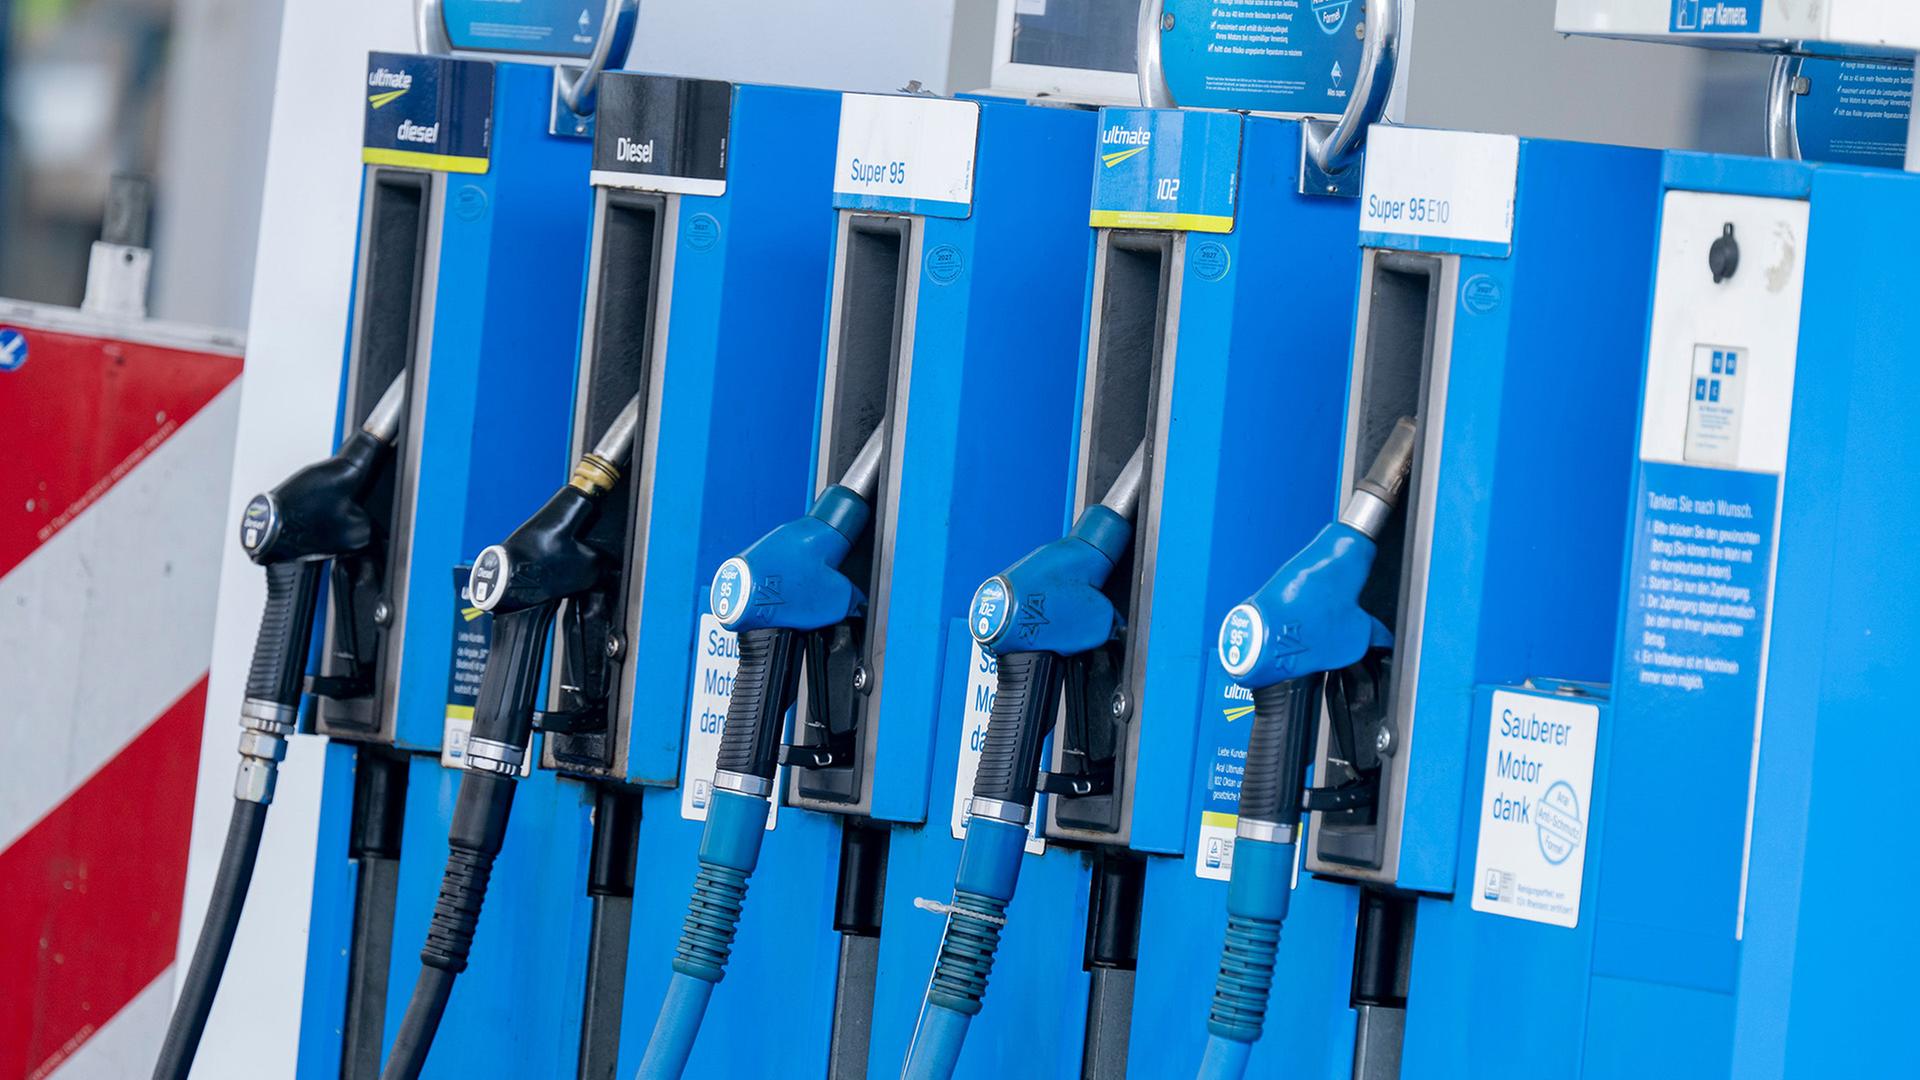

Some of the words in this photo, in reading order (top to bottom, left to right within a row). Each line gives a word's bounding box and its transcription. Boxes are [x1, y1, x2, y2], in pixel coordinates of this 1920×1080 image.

[369, 68, 412, 89] ultimate
[397, 119, 439, 143] diesel
[1102, 126, 1151, 145] ultimate
[616, 138, 654, 163] Diesel
[851, 158, 886, 187] Super
[890, 162, 905, 184] 95
[1156, 178, 1180, 200] 102
[1368, 194, 1405, 224] Super
[1409, 198, 1426, 221] 95
[1427, 199, 1450, 224] E10
[1648, 492, 1678, 510] Tanken
[1679, 495, 1693, 512] Sie
[1695, 498, 1715, 515] nach
[1717, 499, 1753, 519] Wunsch.
[721, 569, 738, 581] Super
[720, 582, 732, 596] 95
[978, 602, 996, 617] 102
[1230, 616, 1249, 628] Super
[1501, 709, 1572, 746] Sauberer
[1497, 750, 1542, 785] Motor
[1493, 792, 1530, 825] dank
